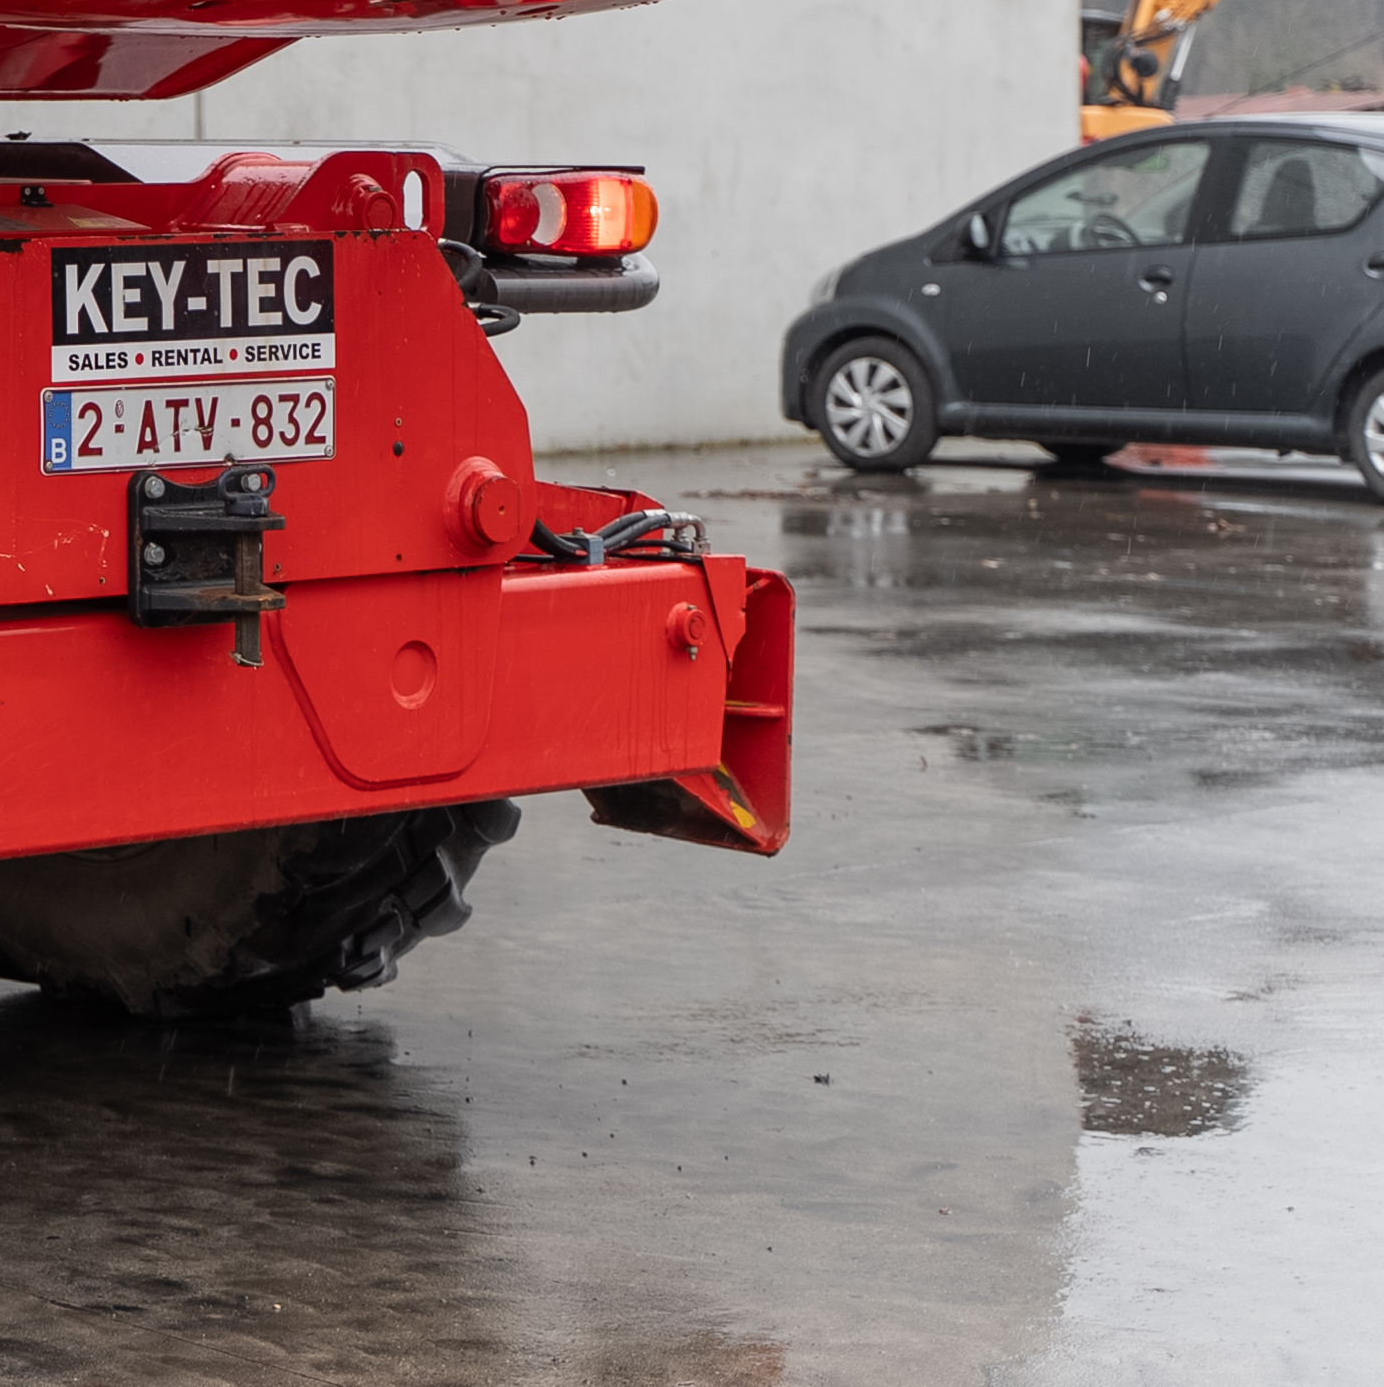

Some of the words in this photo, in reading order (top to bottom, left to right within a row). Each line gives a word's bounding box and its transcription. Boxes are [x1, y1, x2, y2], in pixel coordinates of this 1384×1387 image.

[66, 255, 323, 334] KEY-TEC
[68, 352, 128, 372] SALES
[151, 348, 223, 367] RENTAL
[244, 343, 322, 363] SERVICE
[51, 438, 67, 464] B
[77, 391, 328, 457] 2-ATV-832
